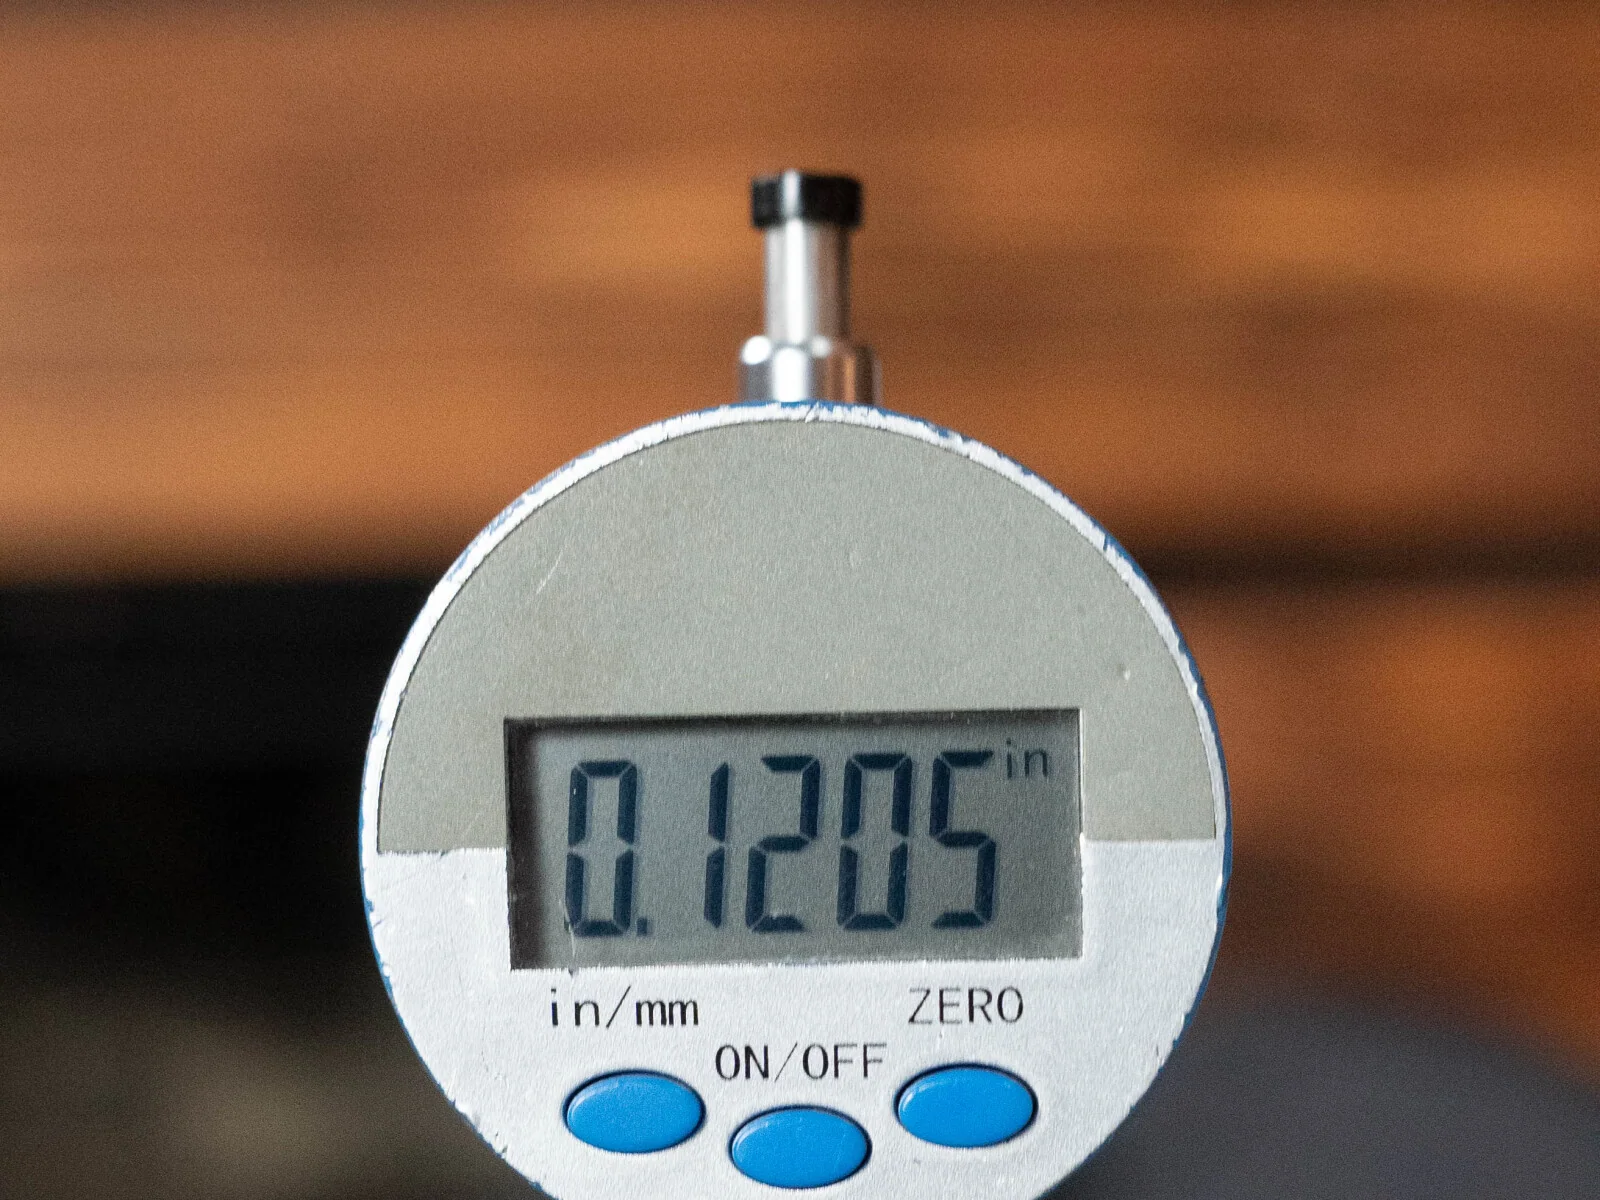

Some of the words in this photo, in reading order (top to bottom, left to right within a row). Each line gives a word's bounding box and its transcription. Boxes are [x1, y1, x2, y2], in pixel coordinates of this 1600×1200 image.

[565, 752, 996, 937] 0.1205
[1004, 737, 1051, 780] in
[550, 986, 700, 1027] in/mm
[907, 987, 1025, 1026] ZERO
[715, 1041, 887, 1082] ON/OFF
